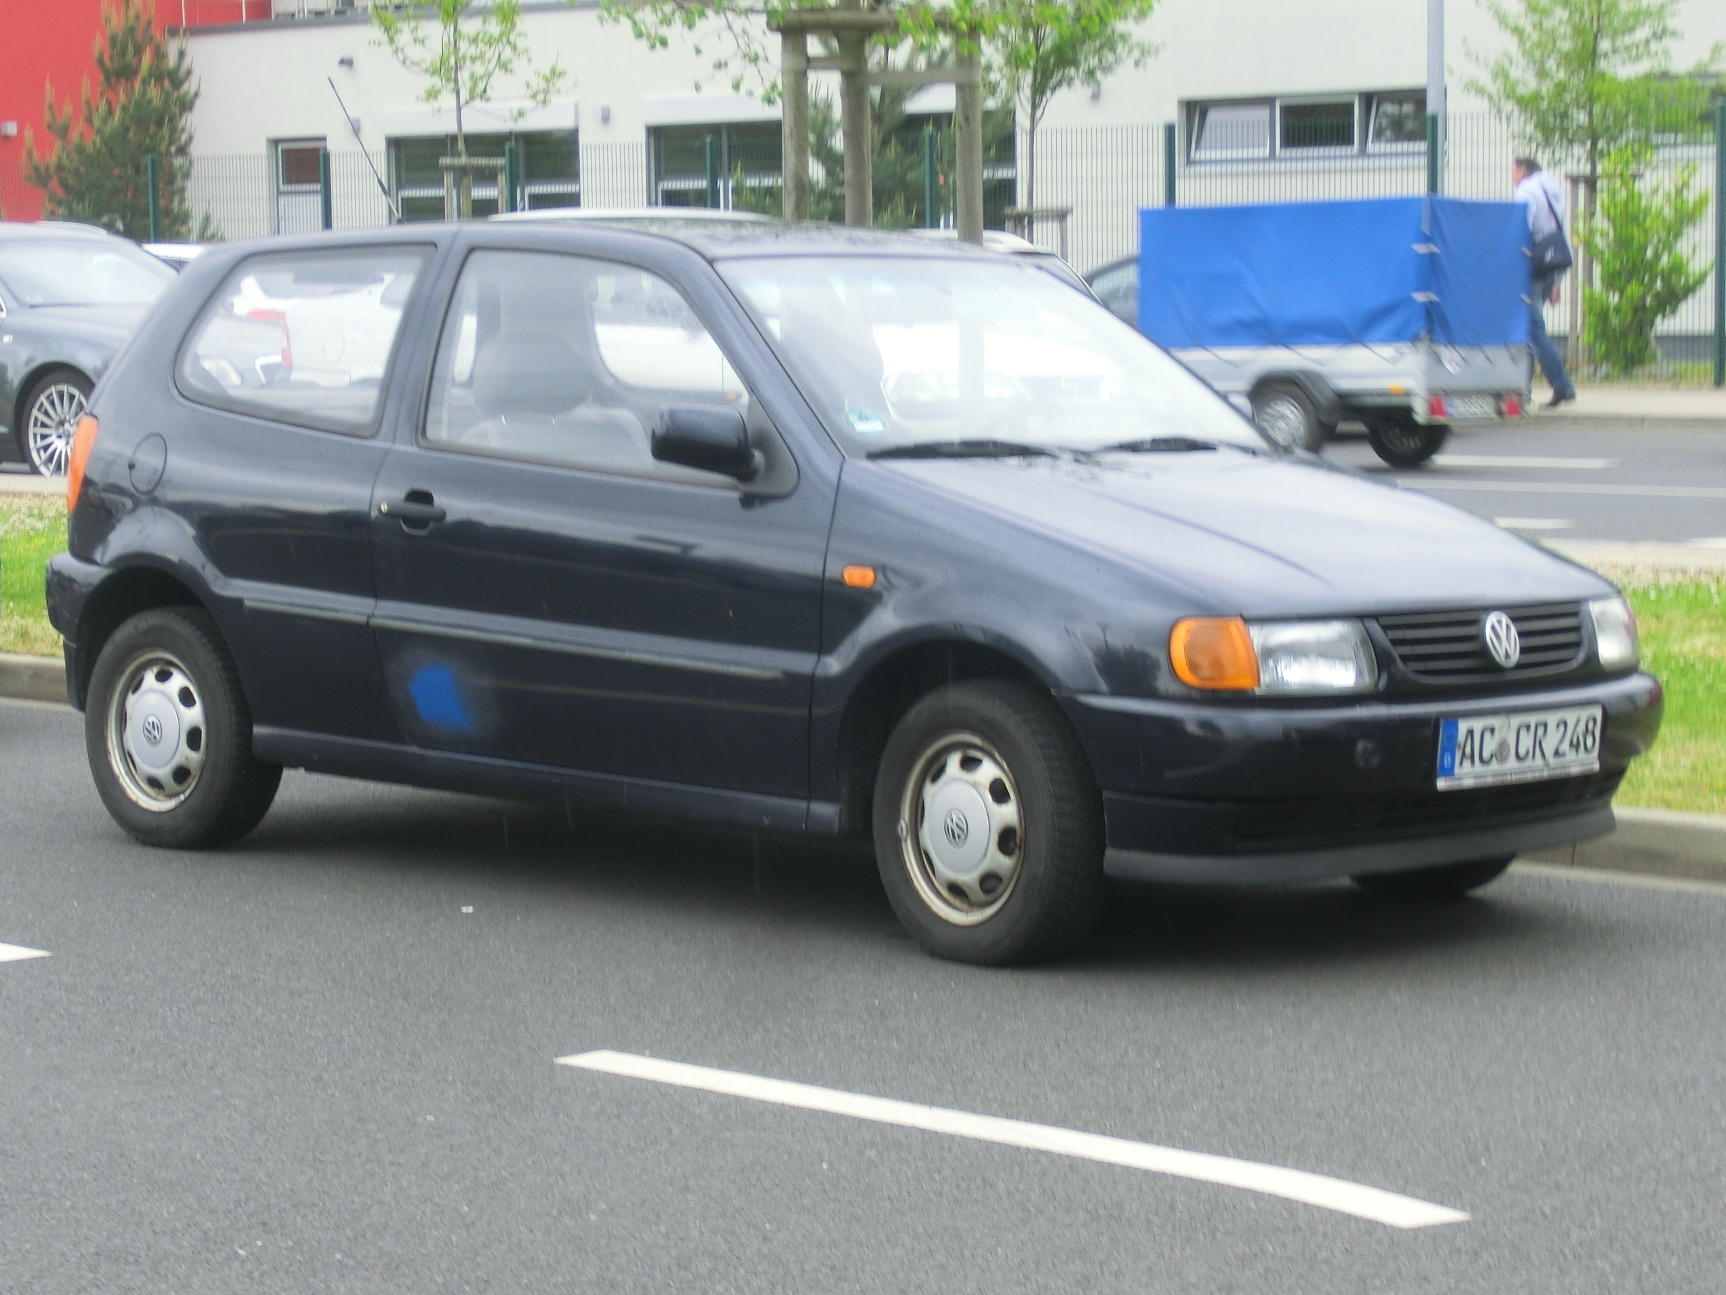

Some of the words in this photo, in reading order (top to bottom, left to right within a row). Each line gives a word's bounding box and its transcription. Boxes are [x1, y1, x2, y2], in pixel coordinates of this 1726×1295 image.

[1486, 611, 1520, 668] VW
[1459, 725, 1496, 768] AC
[1515, 720, 1548, 762] CR
[1553, 715, 1597, 757] 248
